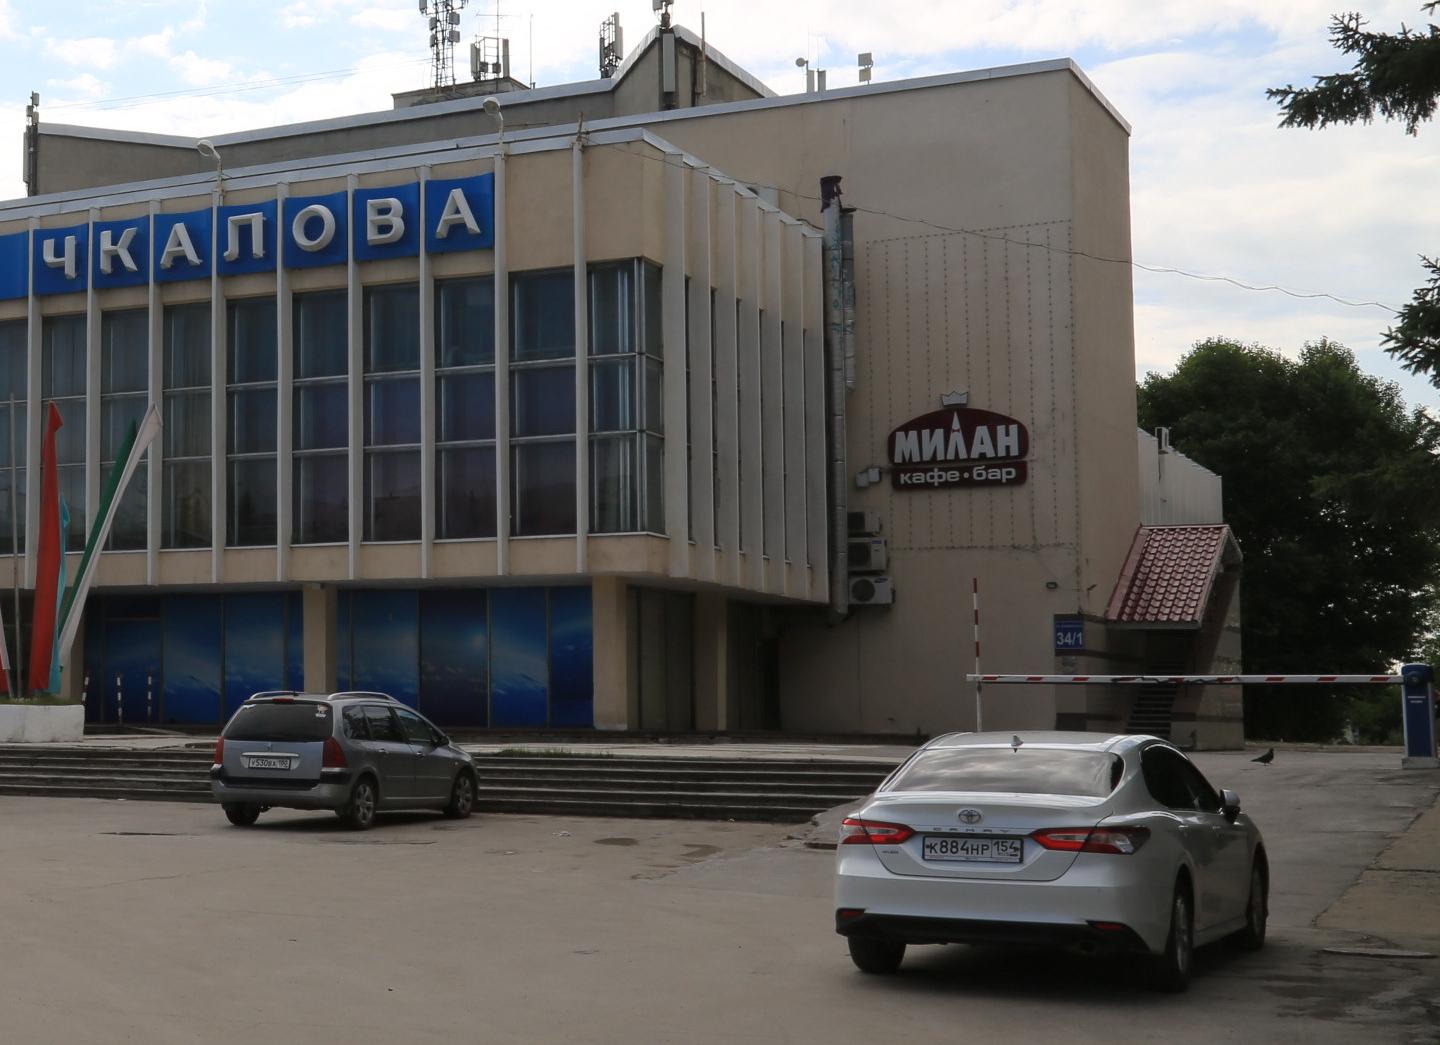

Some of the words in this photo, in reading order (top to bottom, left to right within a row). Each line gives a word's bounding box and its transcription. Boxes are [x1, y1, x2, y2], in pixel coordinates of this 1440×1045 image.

[42, 187, 482, 279] ЧКАЛОВА
[894, 411, 1019, 463] МИЛАН
[900, 467, 960, 487] кафе
[973, 465, 1016, 483] бар
[1056, 631, 1082, 646] 34/1
